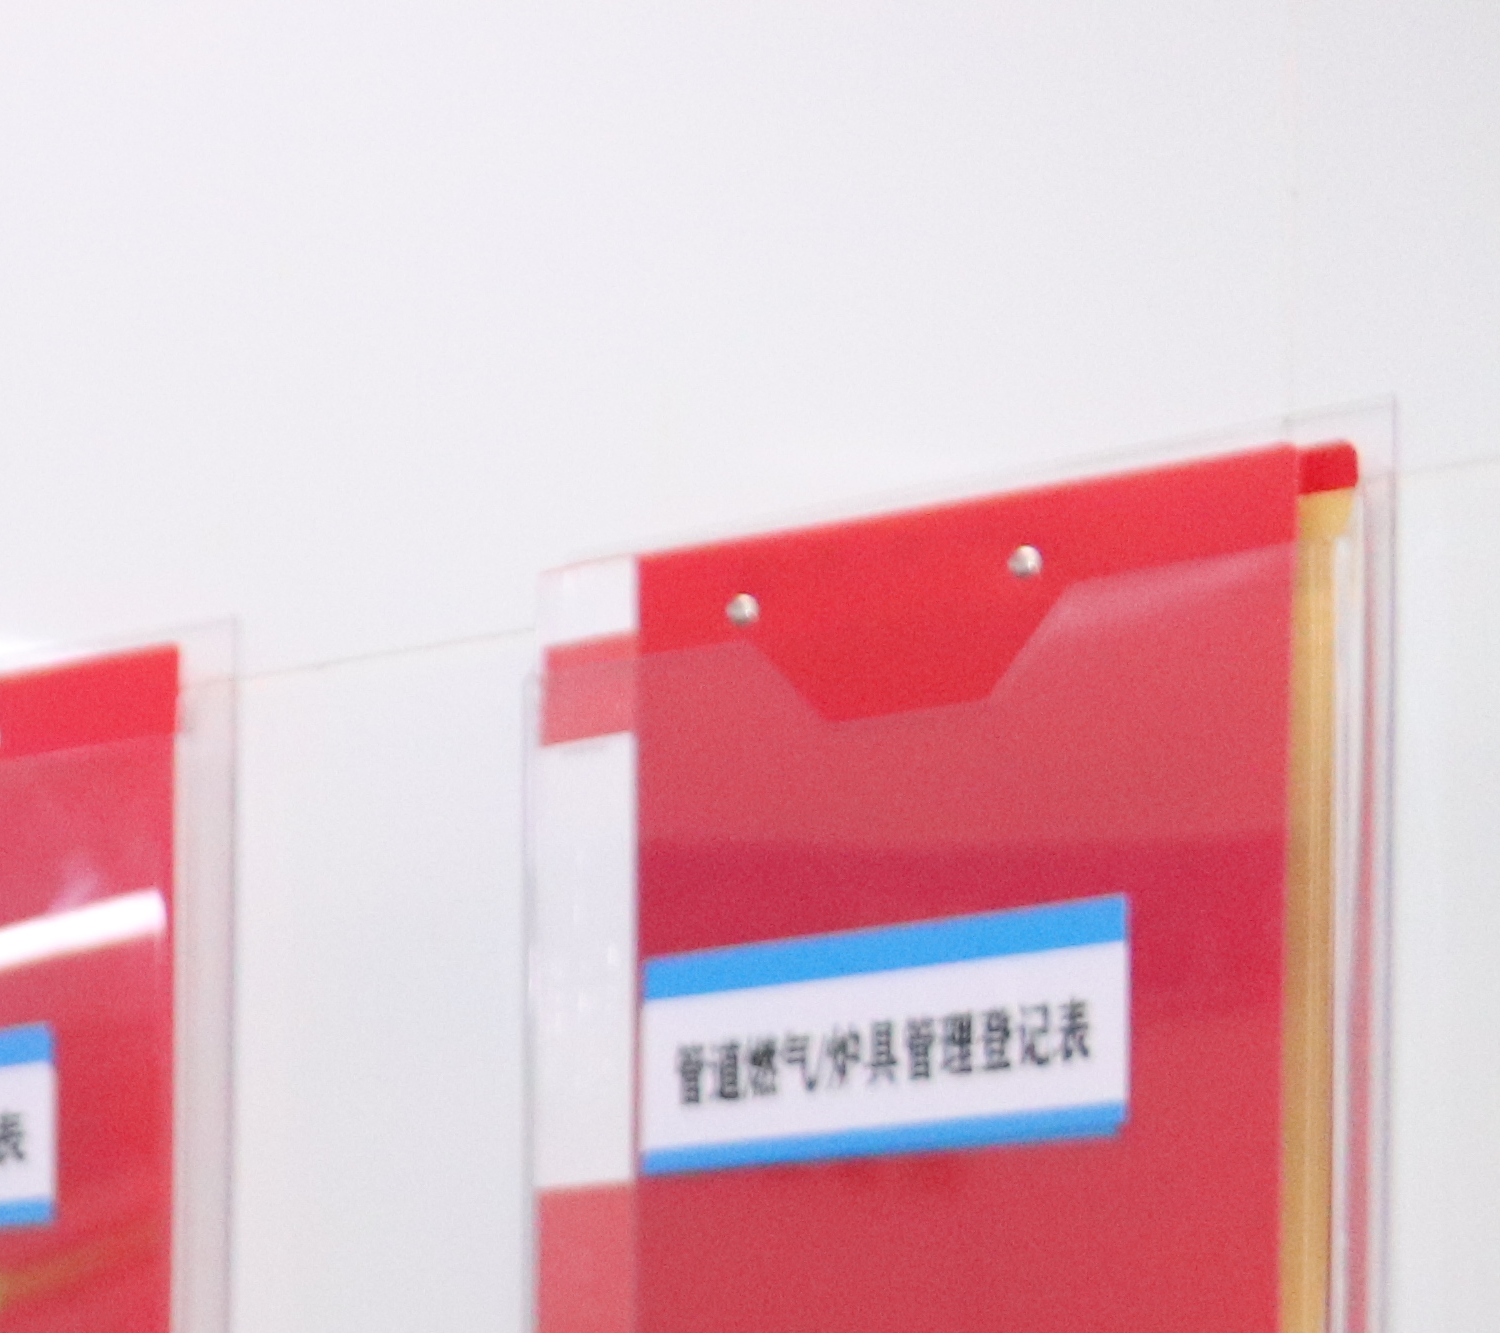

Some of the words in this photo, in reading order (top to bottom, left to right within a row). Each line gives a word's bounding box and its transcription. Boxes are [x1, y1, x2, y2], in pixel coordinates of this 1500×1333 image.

[677, 998, 1091, 1105] 管道燃气/炉具管理登记表
